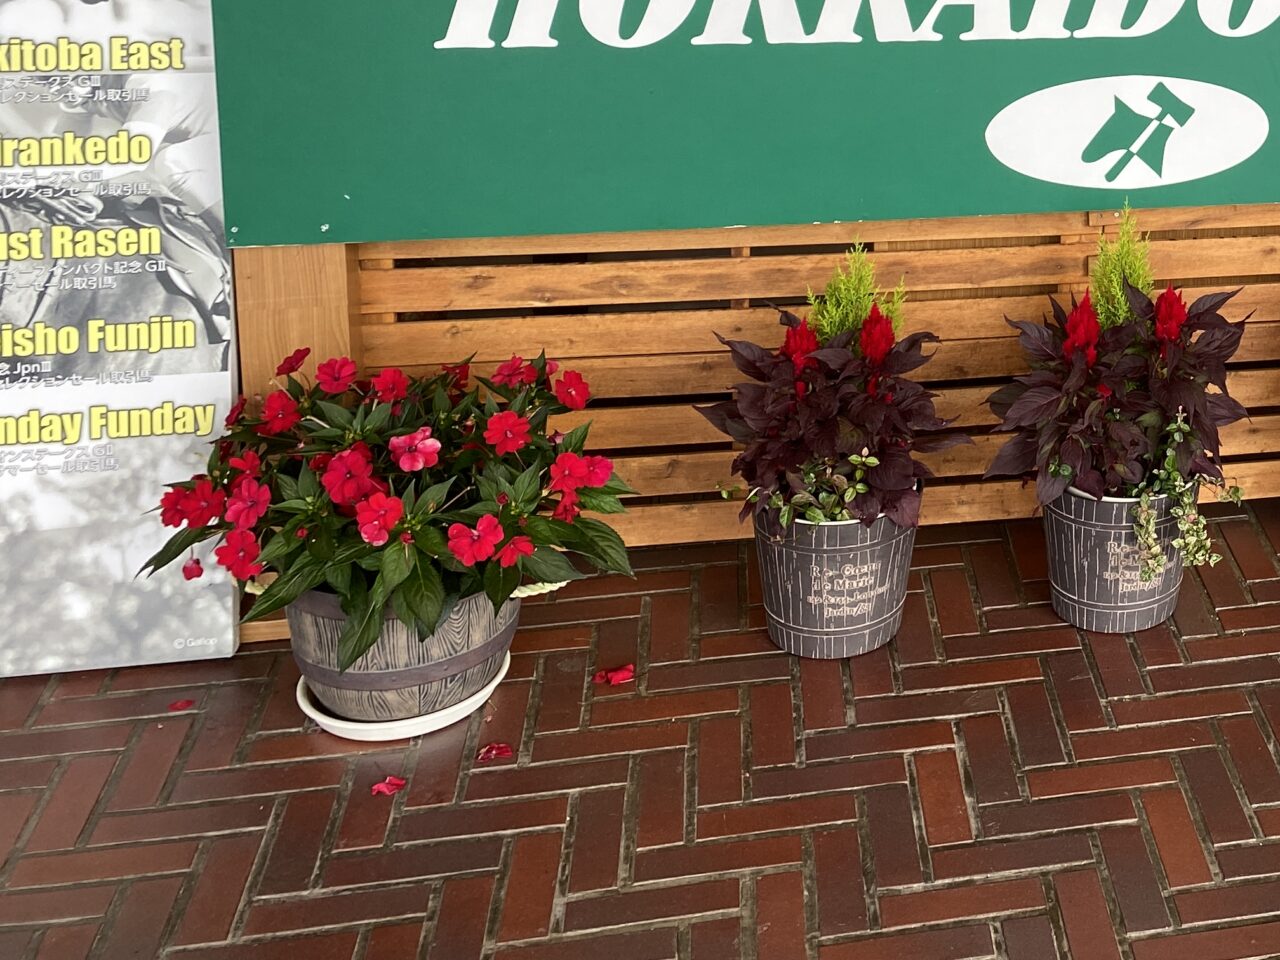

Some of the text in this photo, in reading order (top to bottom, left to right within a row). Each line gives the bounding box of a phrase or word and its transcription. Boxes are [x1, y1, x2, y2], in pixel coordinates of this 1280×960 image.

[109, 35, 185, 71] East
[50, 225, 162, 259] Rasen
[87, 316, 196, 354] Funjin
[90, 400, 216, 440] Funday
